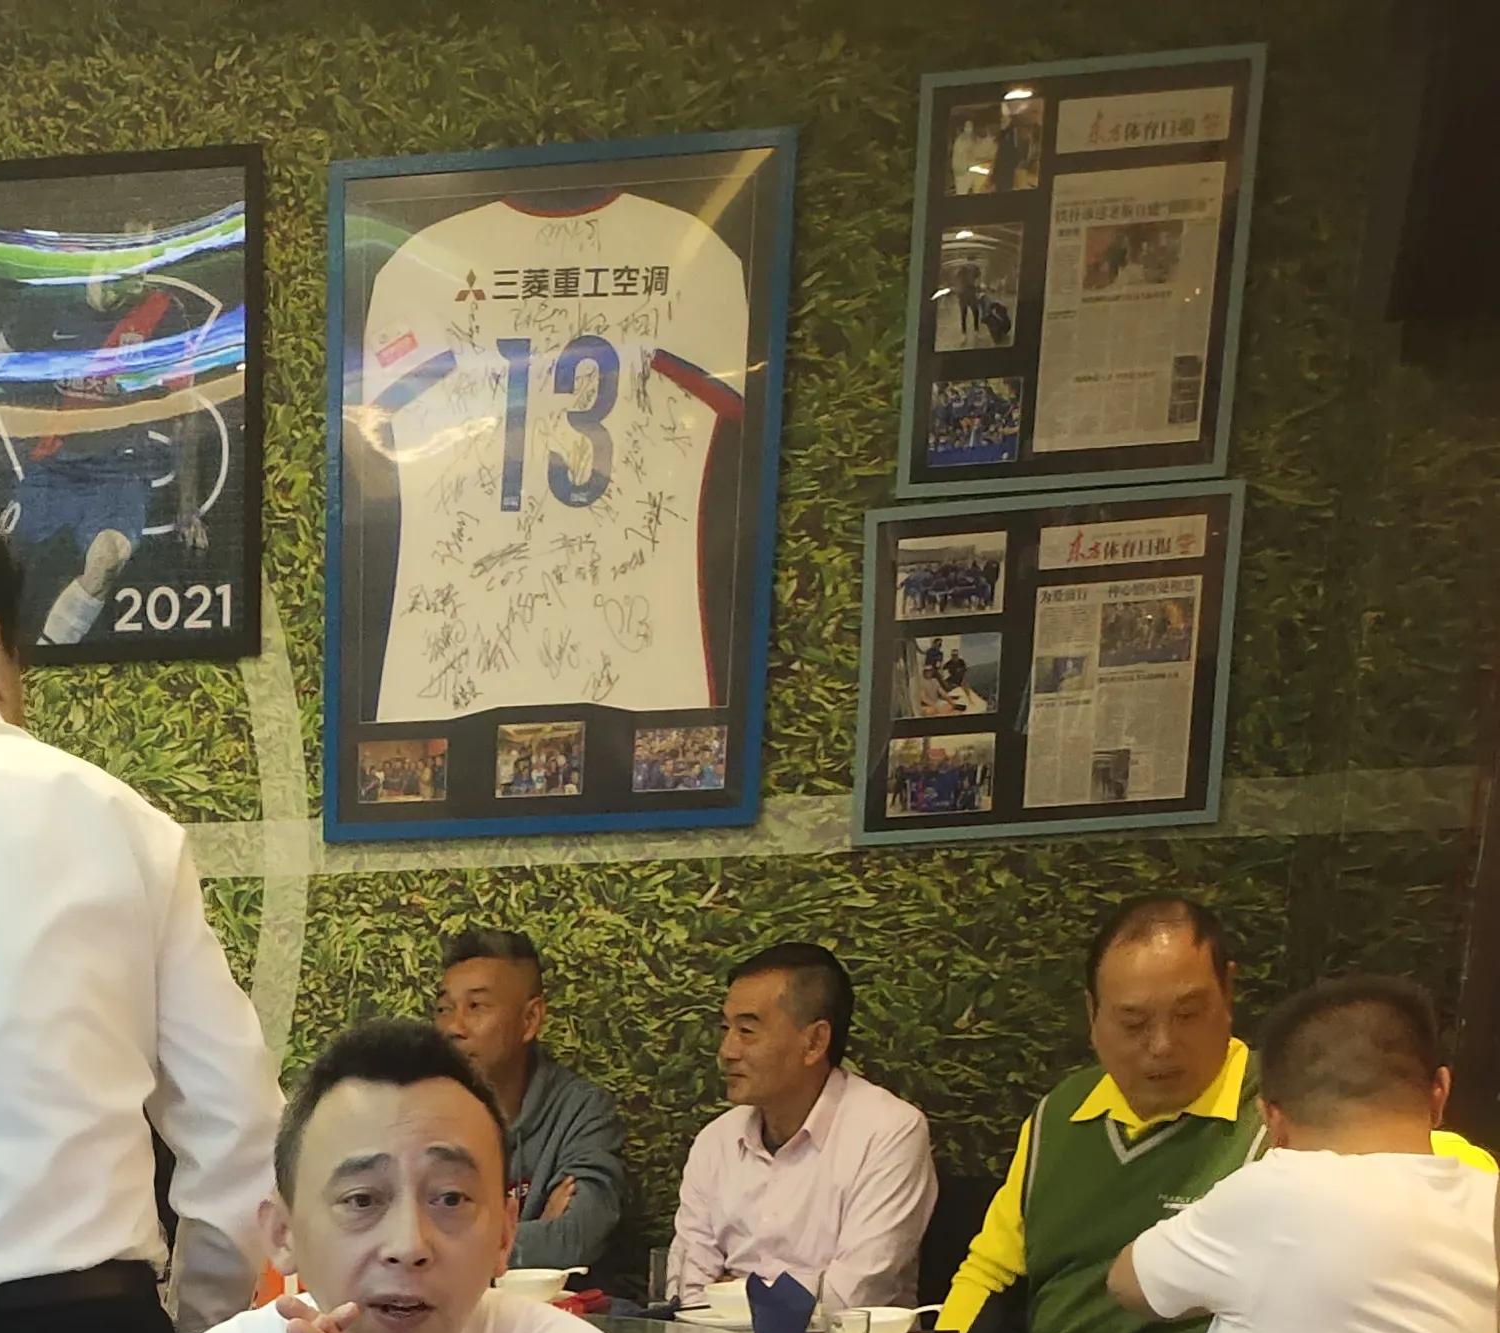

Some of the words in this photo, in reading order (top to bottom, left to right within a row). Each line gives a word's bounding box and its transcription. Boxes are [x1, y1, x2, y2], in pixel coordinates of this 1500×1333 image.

[492, 263, 671, 299] 三菱重工空调
[494, 335, 622, 513] 13
[113, 582, 233, 632] 2021
